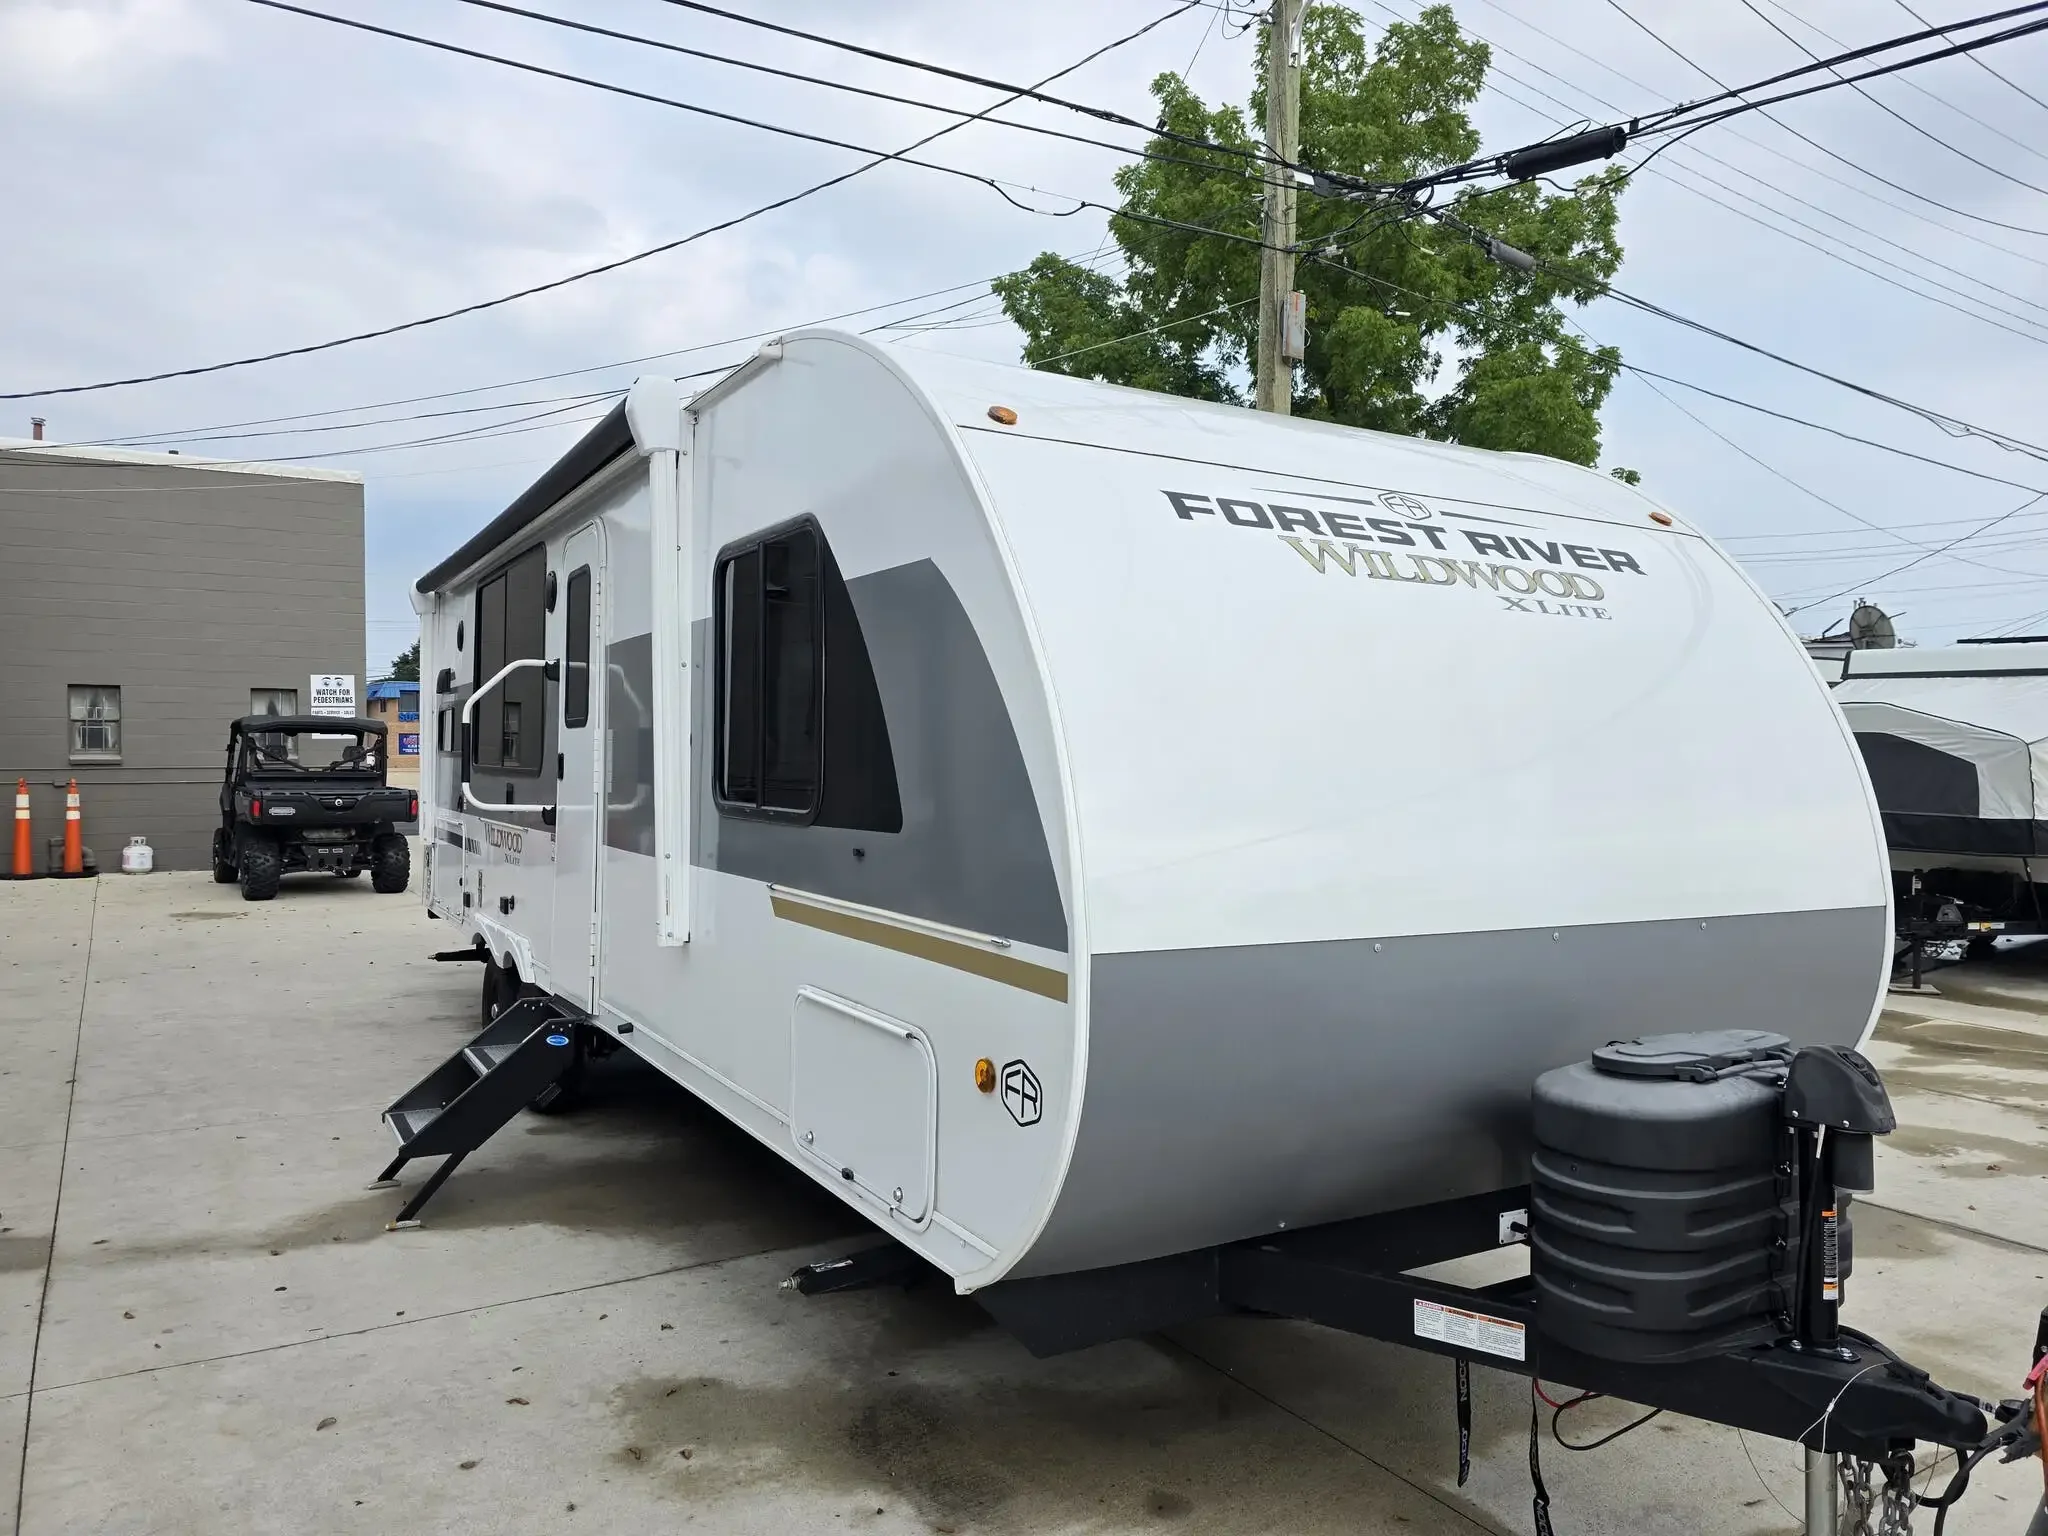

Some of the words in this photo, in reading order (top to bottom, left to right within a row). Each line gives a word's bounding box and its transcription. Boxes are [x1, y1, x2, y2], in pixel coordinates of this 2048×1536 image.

[1159, 489, 1448, 551] FOREST
[1457, 528, 1649, 576] RIVER
[1277, 534, 1605, 601] WILDWOOD
[313, 696, 354, 704] PEDESTRIANS
[315, 688, 337, 696] WATCH
[338, 688, 351, 696] FOR
[484, 822, 523, 854] WILDWOOD
